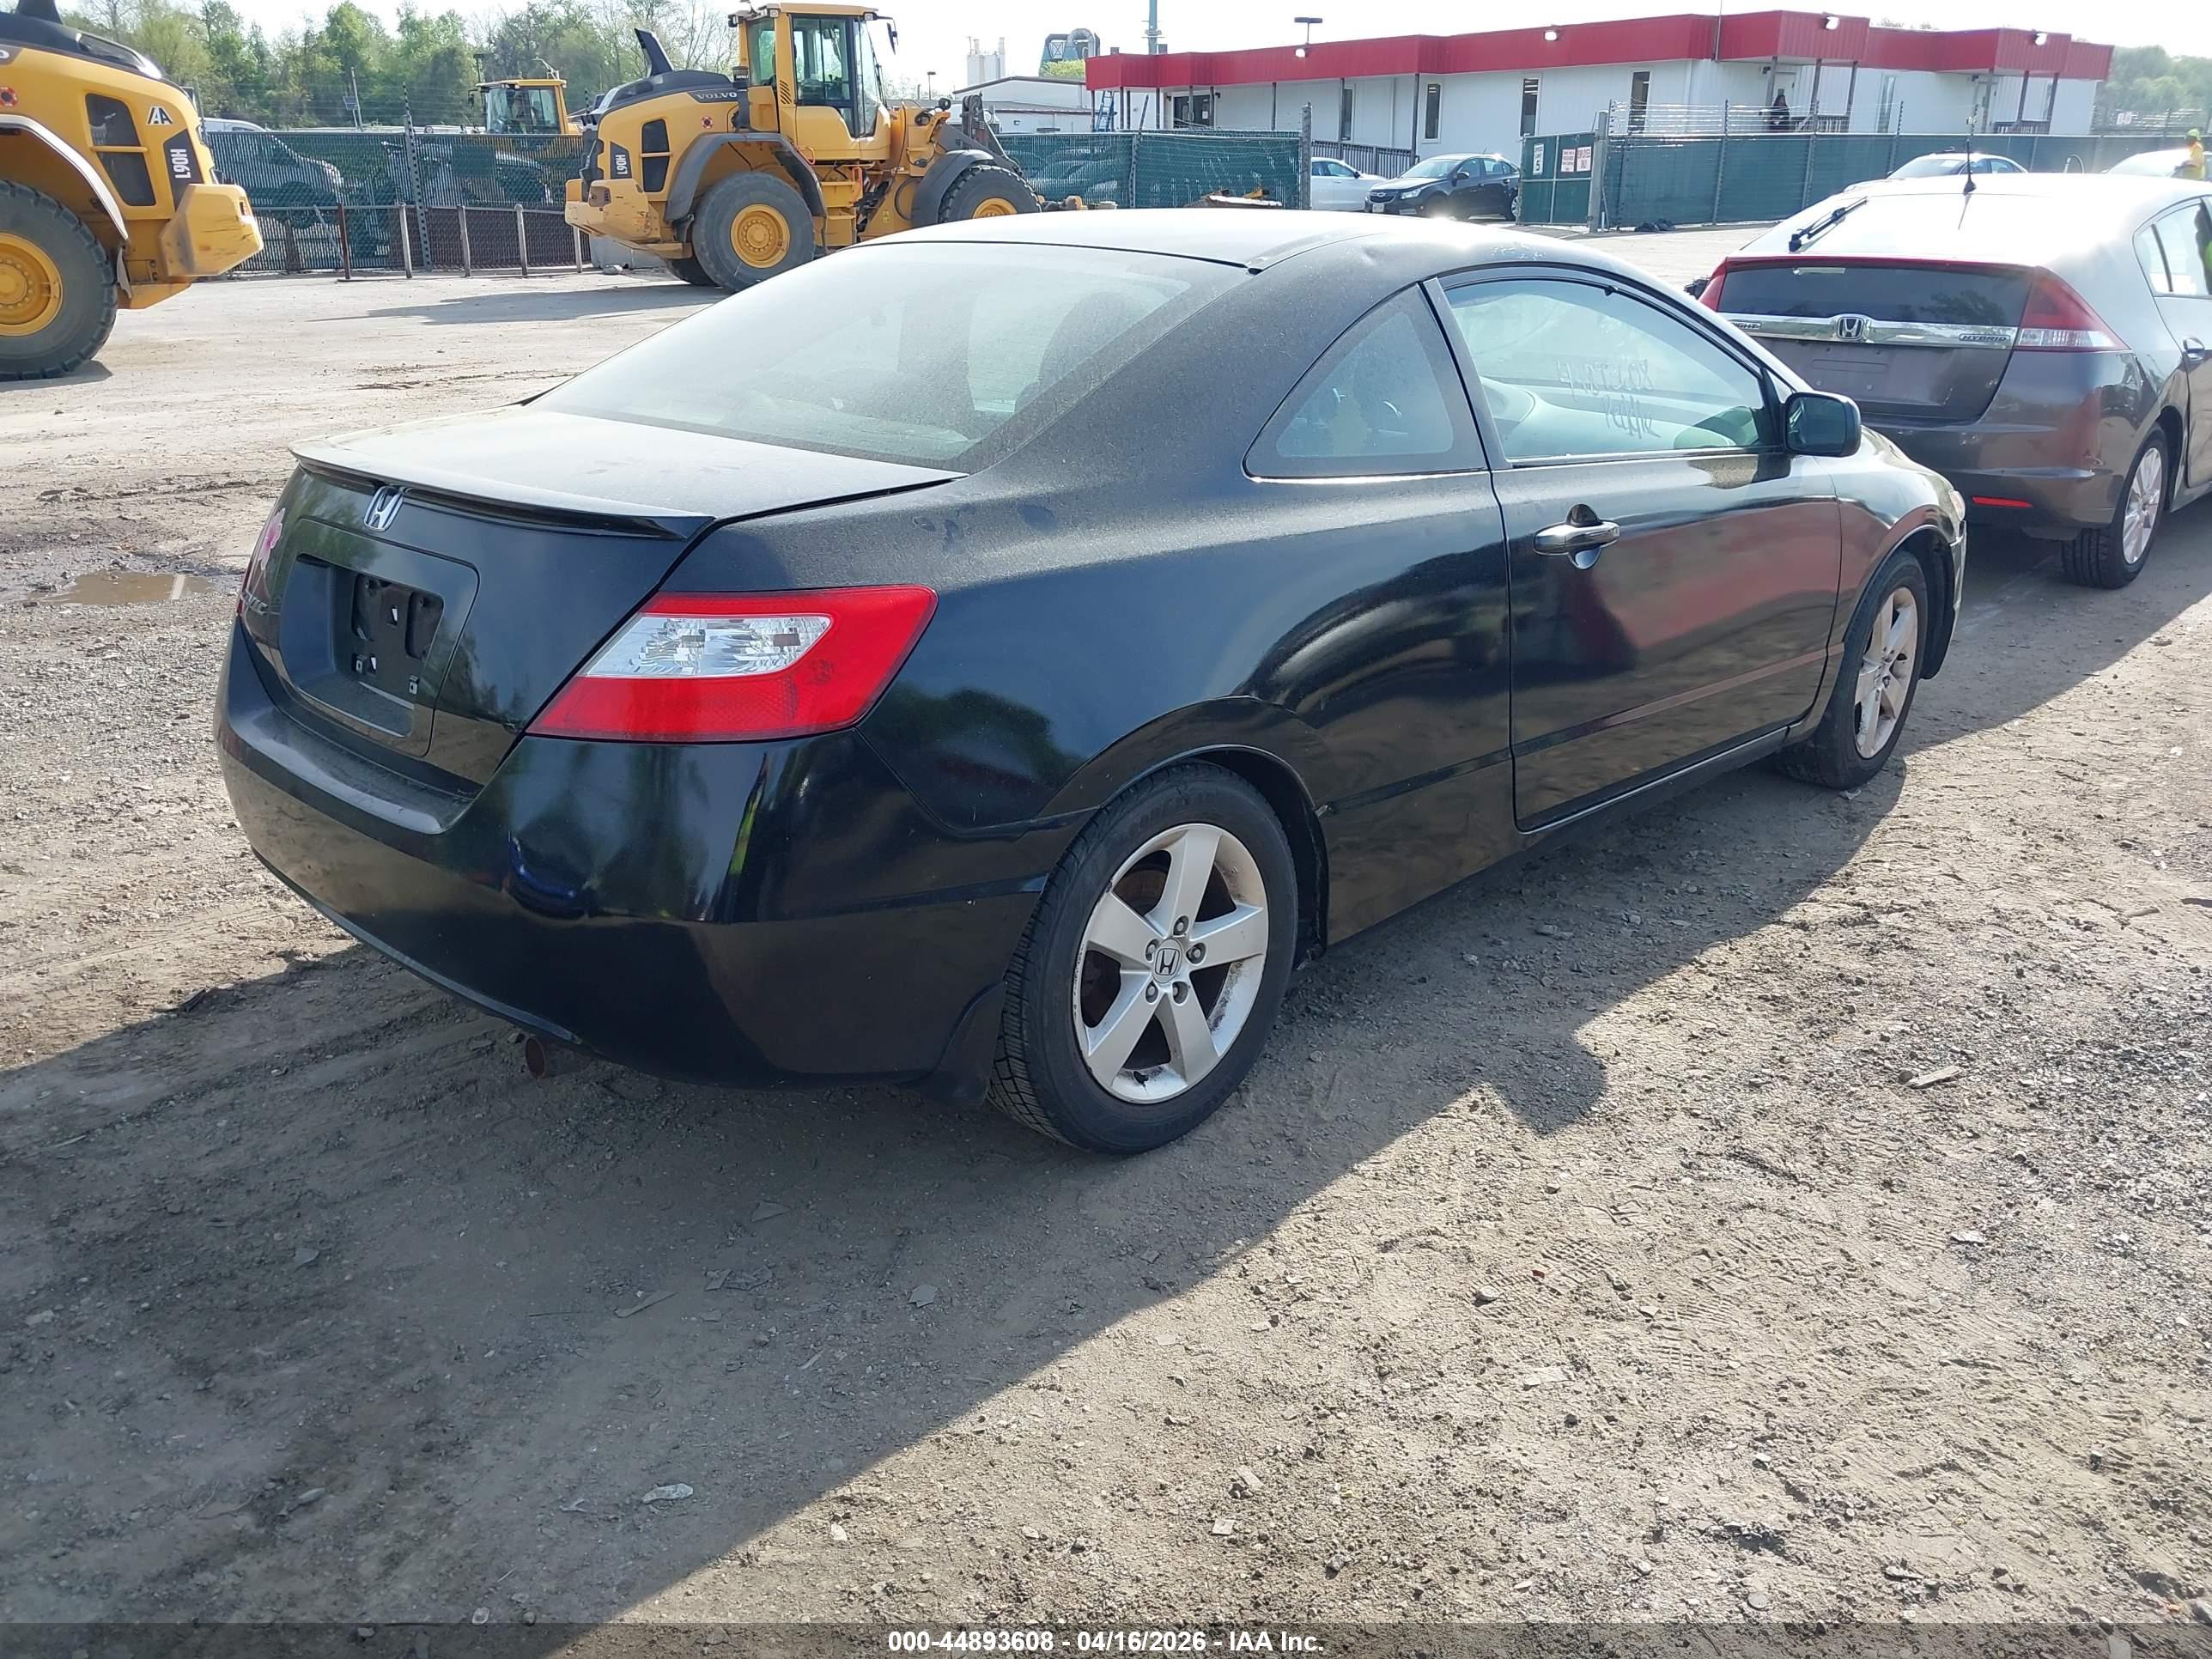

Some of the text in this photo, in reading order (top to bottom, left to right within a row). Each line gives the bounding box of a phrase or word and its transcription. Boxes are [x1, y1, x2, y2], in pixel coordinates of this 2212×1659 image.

[170, 149, 191, 179] L90H
[616, 155, 629, 174] L90H
[1535, 161, 1540, 171] 5
